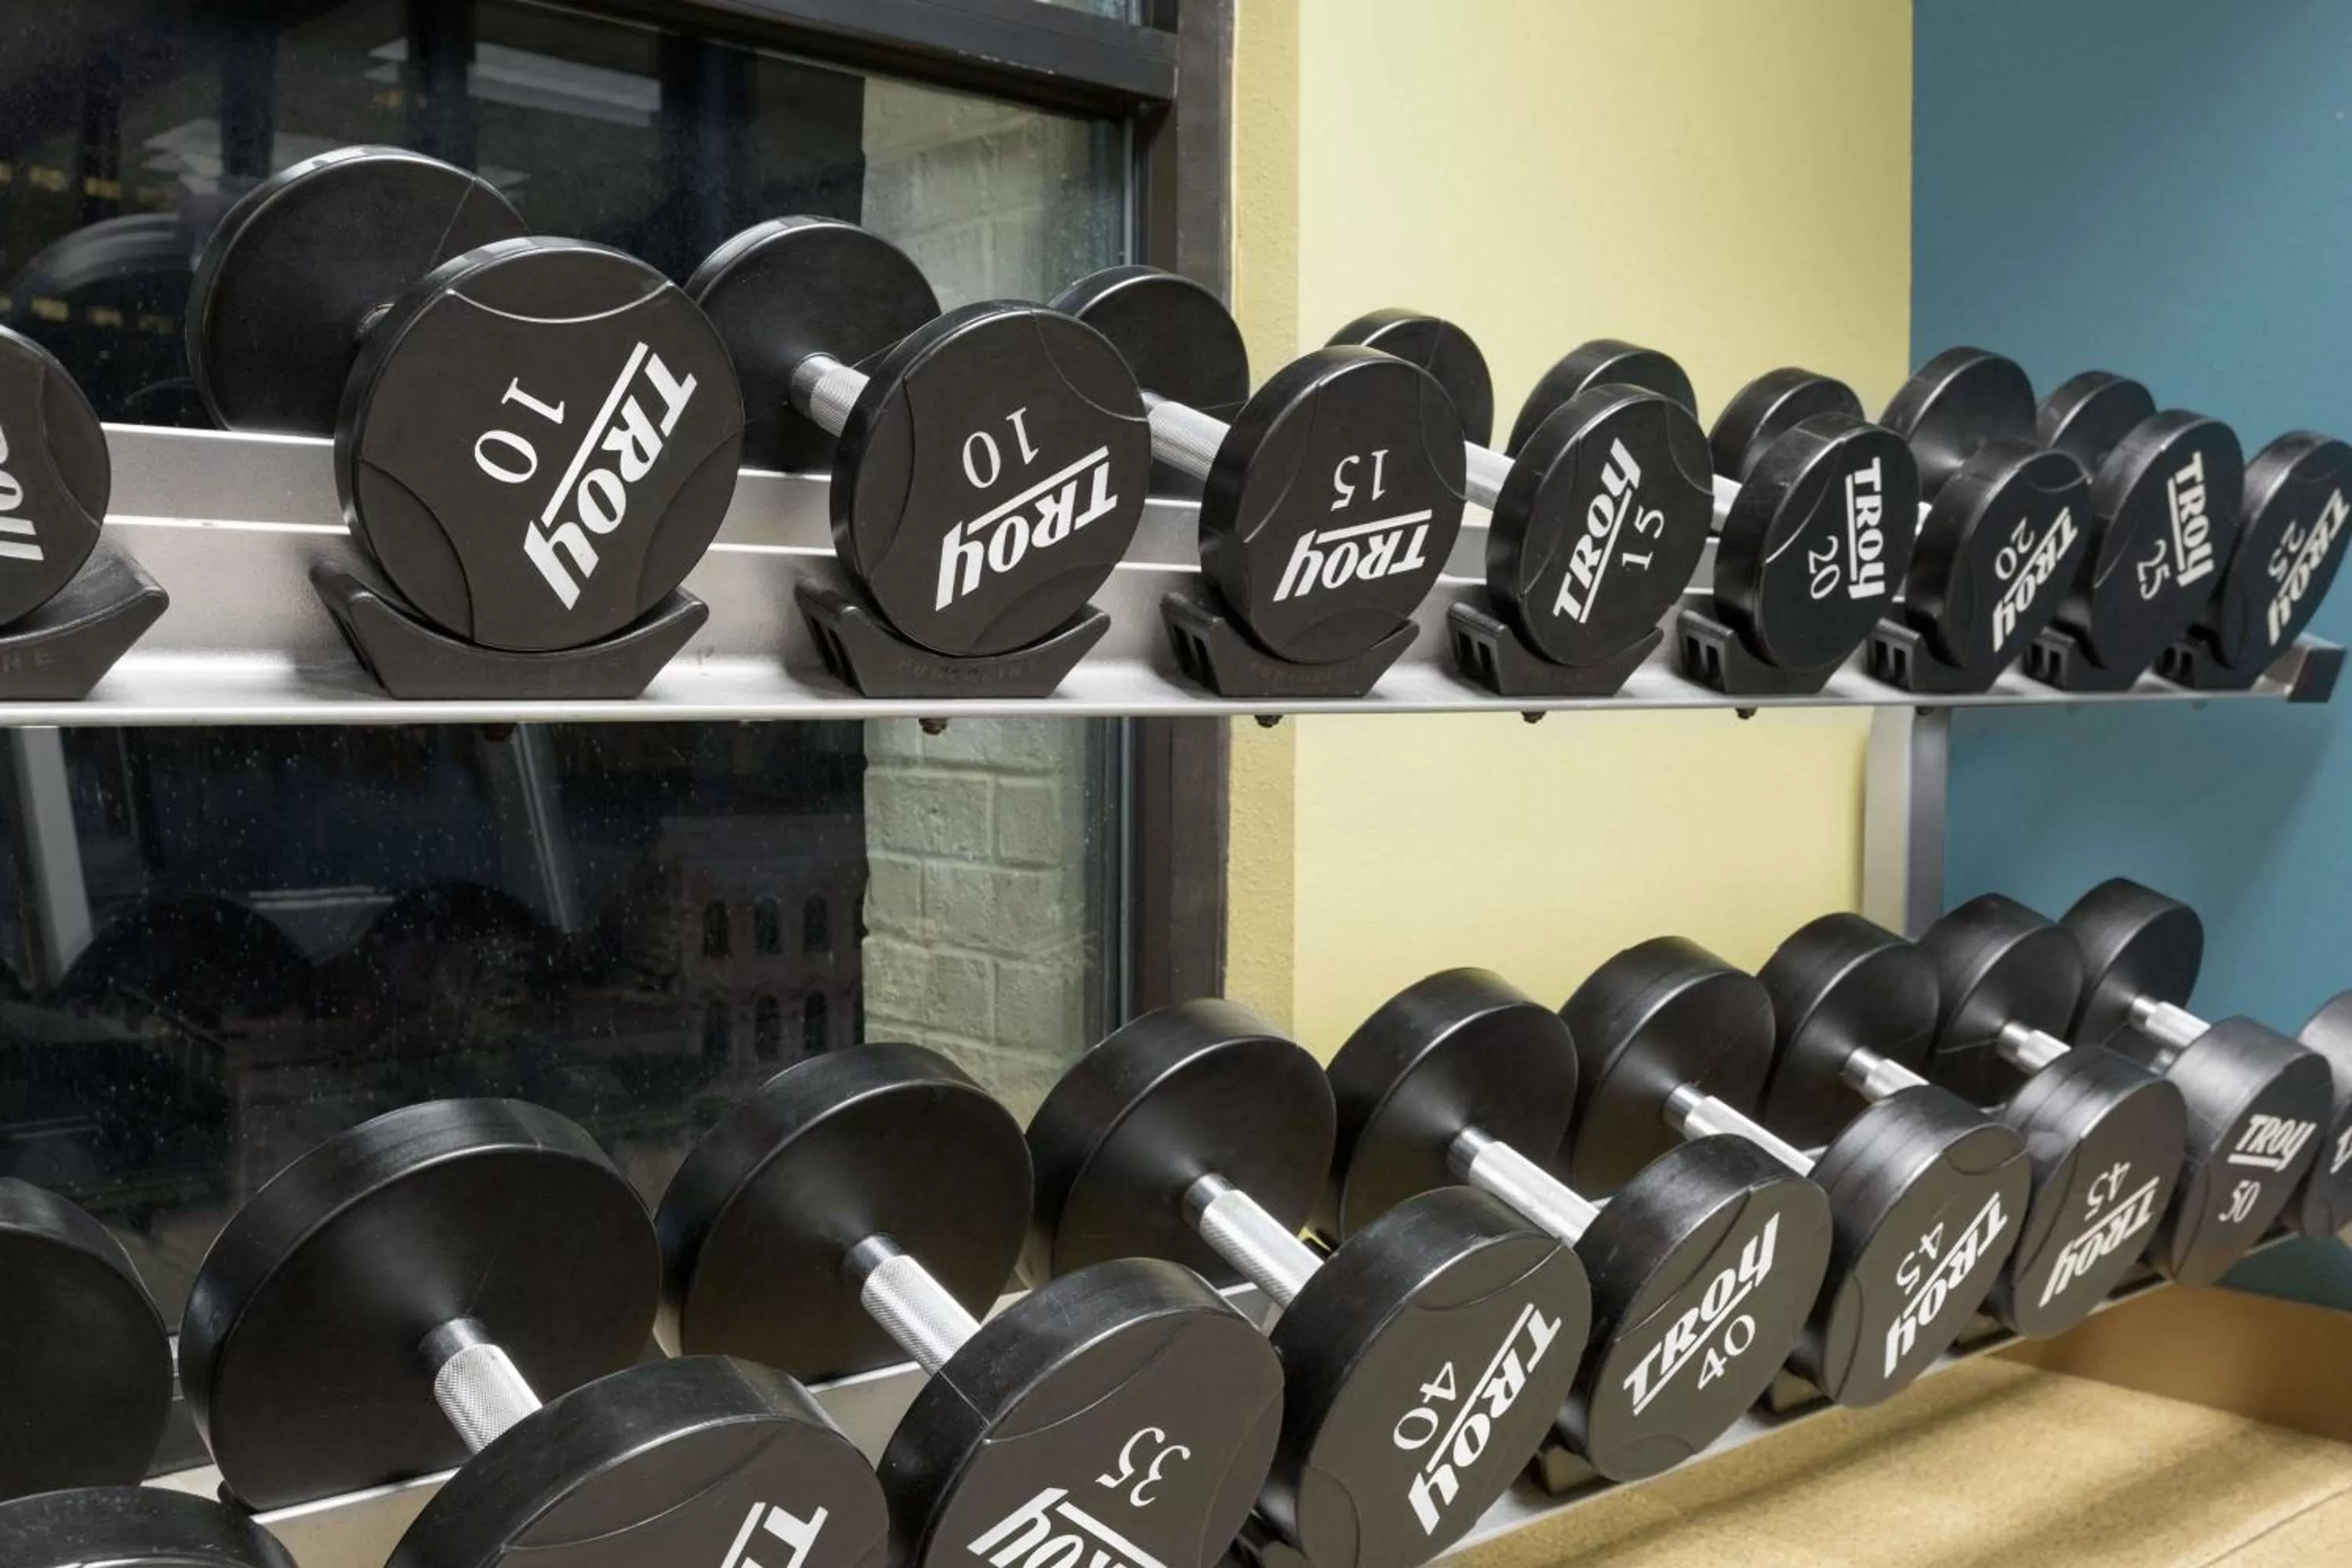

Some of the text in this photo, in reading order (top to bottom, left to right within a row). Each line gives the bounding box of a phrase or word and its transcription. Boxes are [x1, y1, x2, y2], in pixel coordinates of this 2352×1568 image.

[475, 377, 564, 483] 10
[963, 408, 1038, 488] 10
[1331, 450, 1388, 511] 15
[1623, 506, 1664, 570] 15
[1809, 535, 1840, 600] 20
[1995, 518, 2034, 580] 20
[2137, 539, 2170, 600] 25
[2267, 520, 2305, 582] 25
[2085, 1161, 2130, 1221] 45
[2219, 1180, 2261, 1223] 50
[1896, 1221, 1944, 1296] 45
[1697, 1314, 1756, 1391] 40
[1393, 1362, 1457, 1450] 40
[1095, 1427, 1190, 1507] 35
